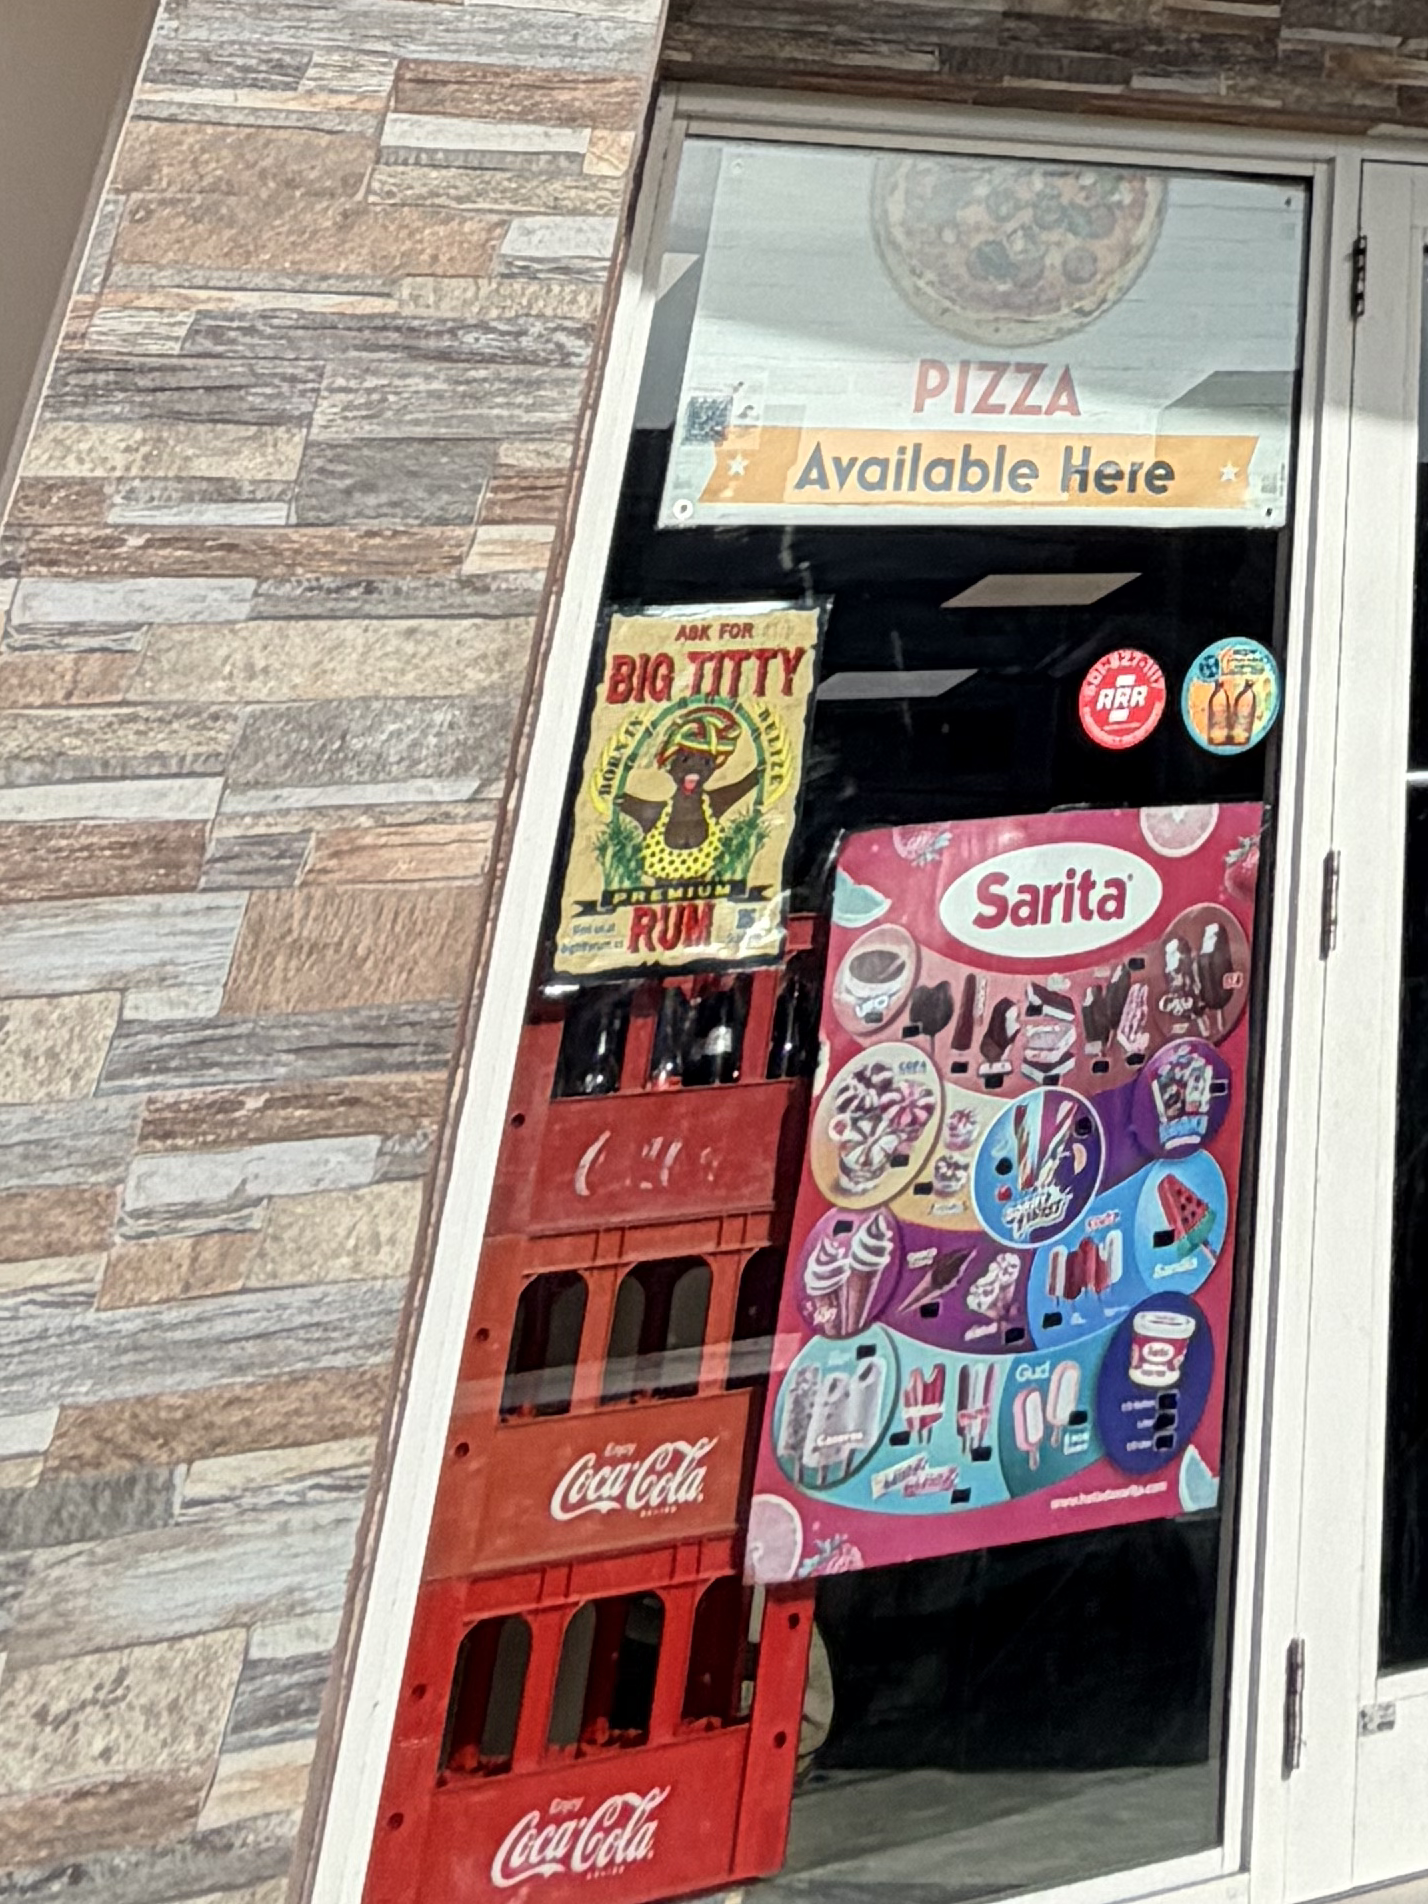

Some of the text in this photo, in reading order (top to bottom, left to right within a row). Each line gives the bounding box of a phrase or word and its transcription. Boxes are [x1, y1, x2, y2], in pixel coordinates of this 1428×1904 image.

[913, 358, 1082, 417] PIZZA
[794, 440, 1177, 496] Available Here
[674, 622, 755, 642] ASK FOR
[605, 646, 807, 705] BIG TITTY
[612, 883, 732, 905] PREMIUM
[971, 867, 1128, 931] Sarita
[627, 900, 717, 954] RUM
[549, 1435, 720, 1522] Coca-Cola
[490, 1784, 672, 1889] Coca-Cola
